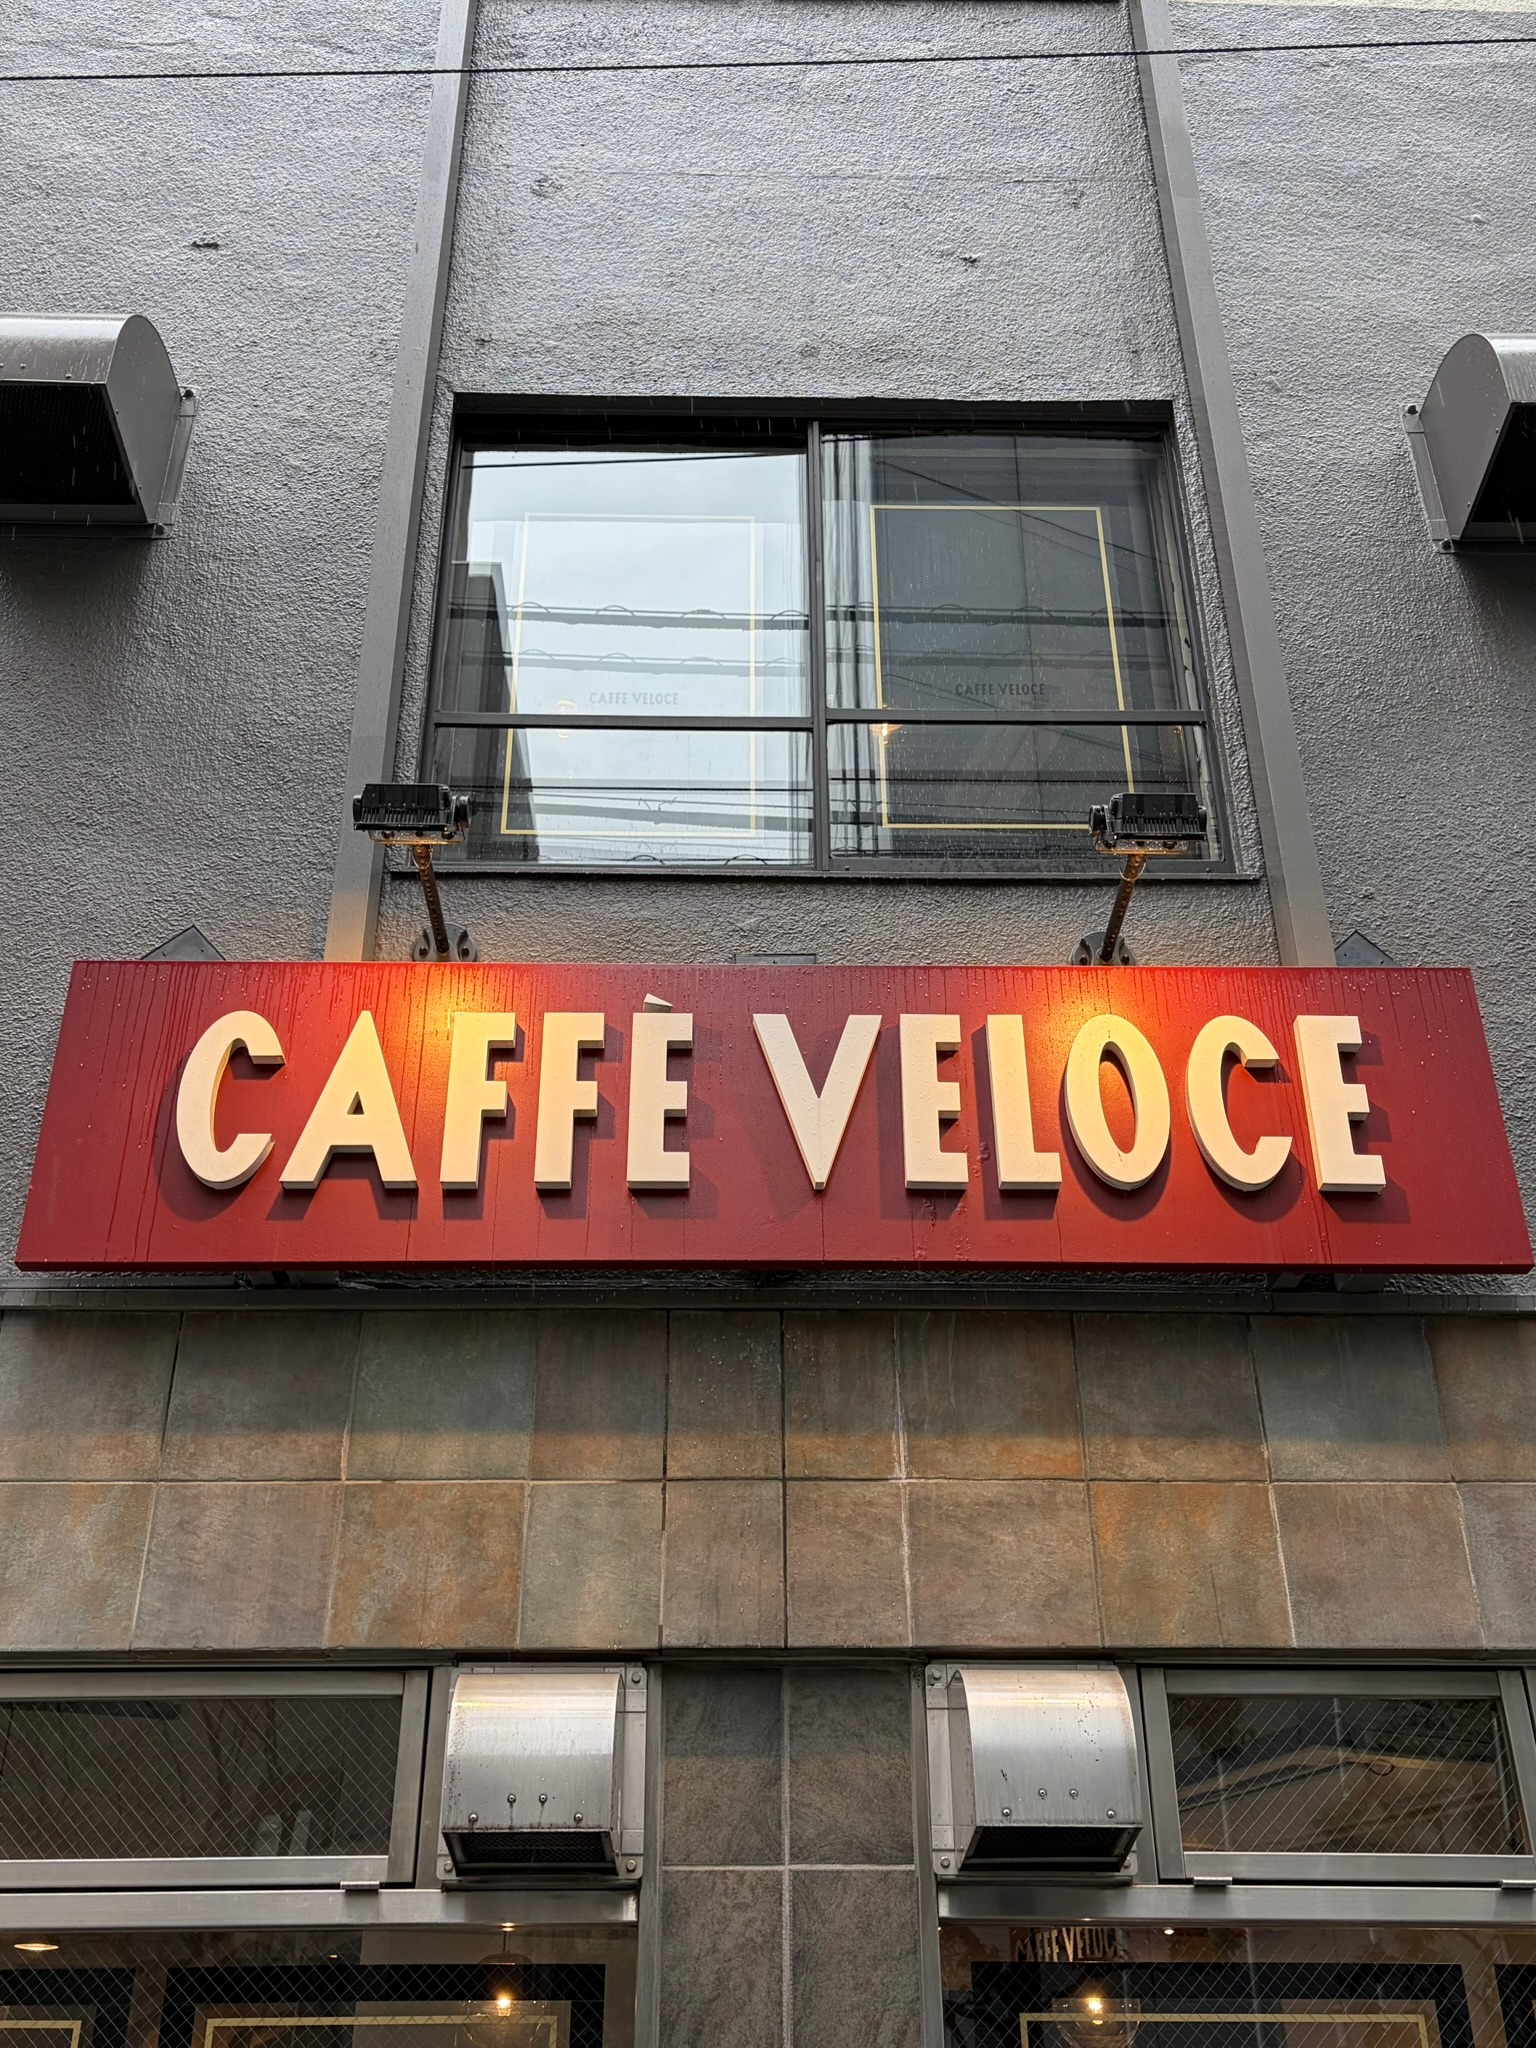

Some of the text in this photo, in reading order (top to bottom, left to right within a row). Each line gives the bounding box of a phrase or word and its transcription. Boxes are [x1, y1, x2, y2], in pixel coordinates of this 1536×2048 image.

[998, 683, 1045, 696] VELOCE
[632, 692, 679, 705] VELOCE
[176, 993, 1386, 1192] CAFFÈ VELOCE
